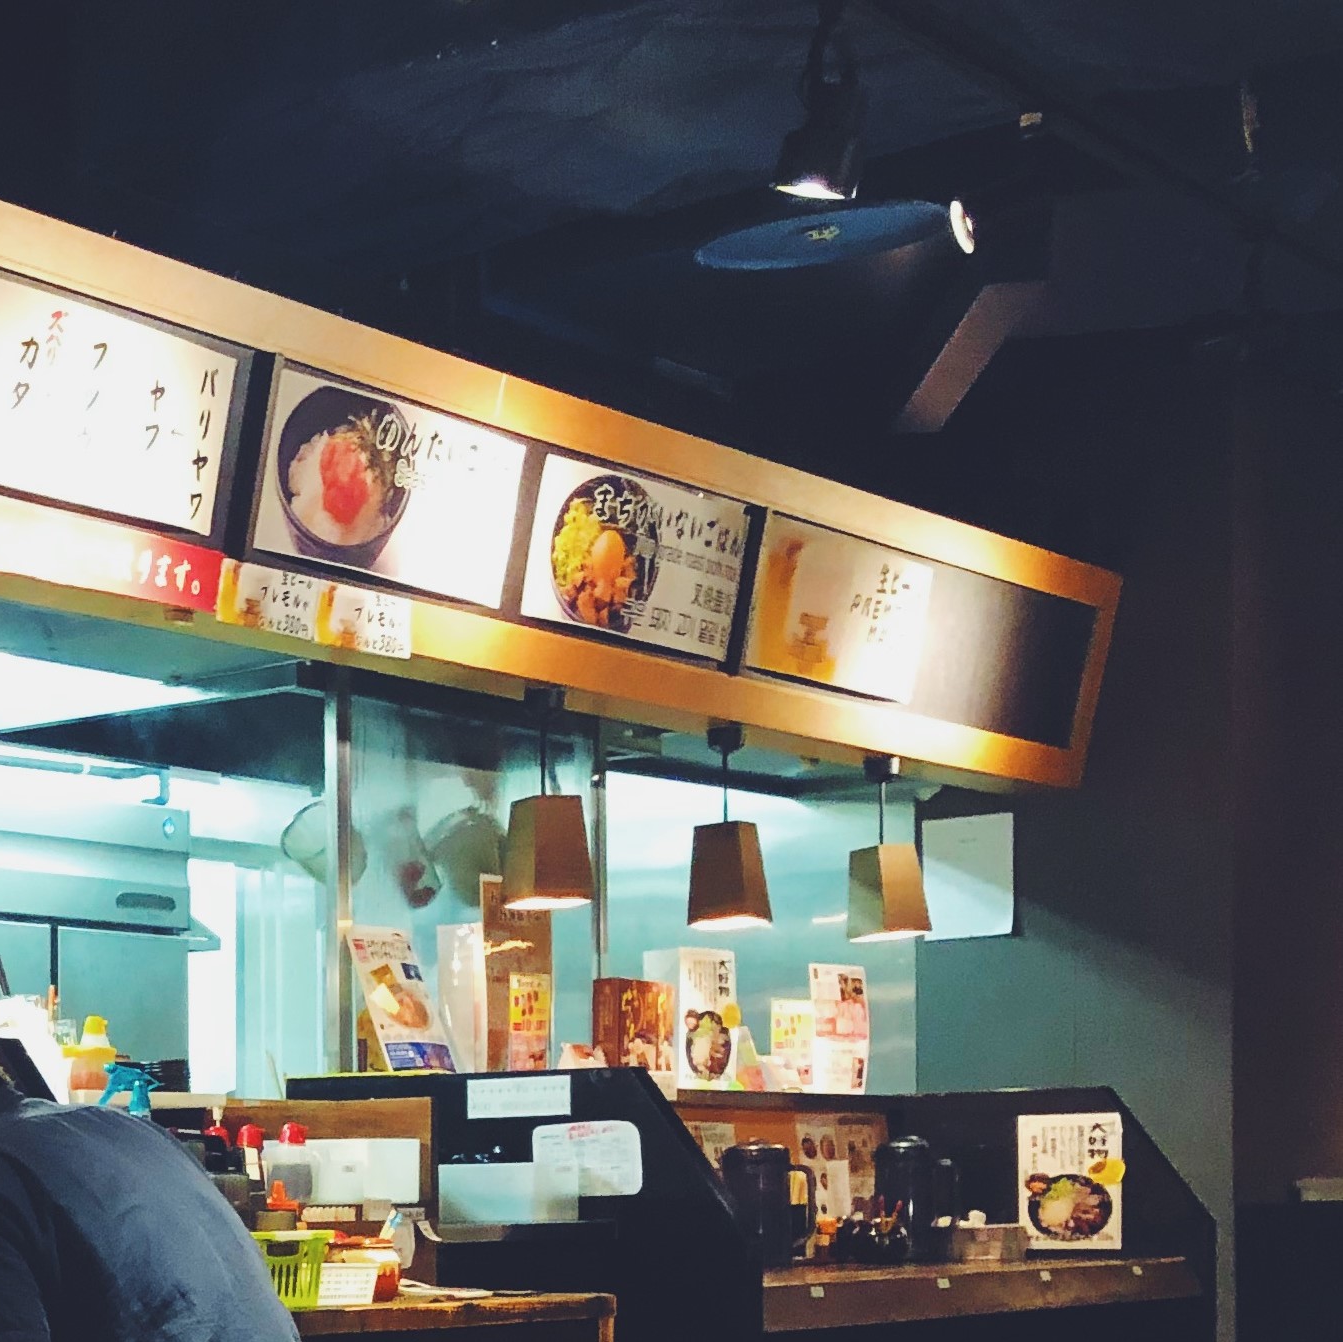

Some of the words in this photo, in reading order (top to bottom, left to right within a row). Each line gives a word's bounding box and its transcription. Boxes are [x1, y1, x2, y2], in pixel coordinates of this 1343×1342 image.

[11, 336, 40, 410] カタ
[190, 368, 219, 521] バリヤワ
